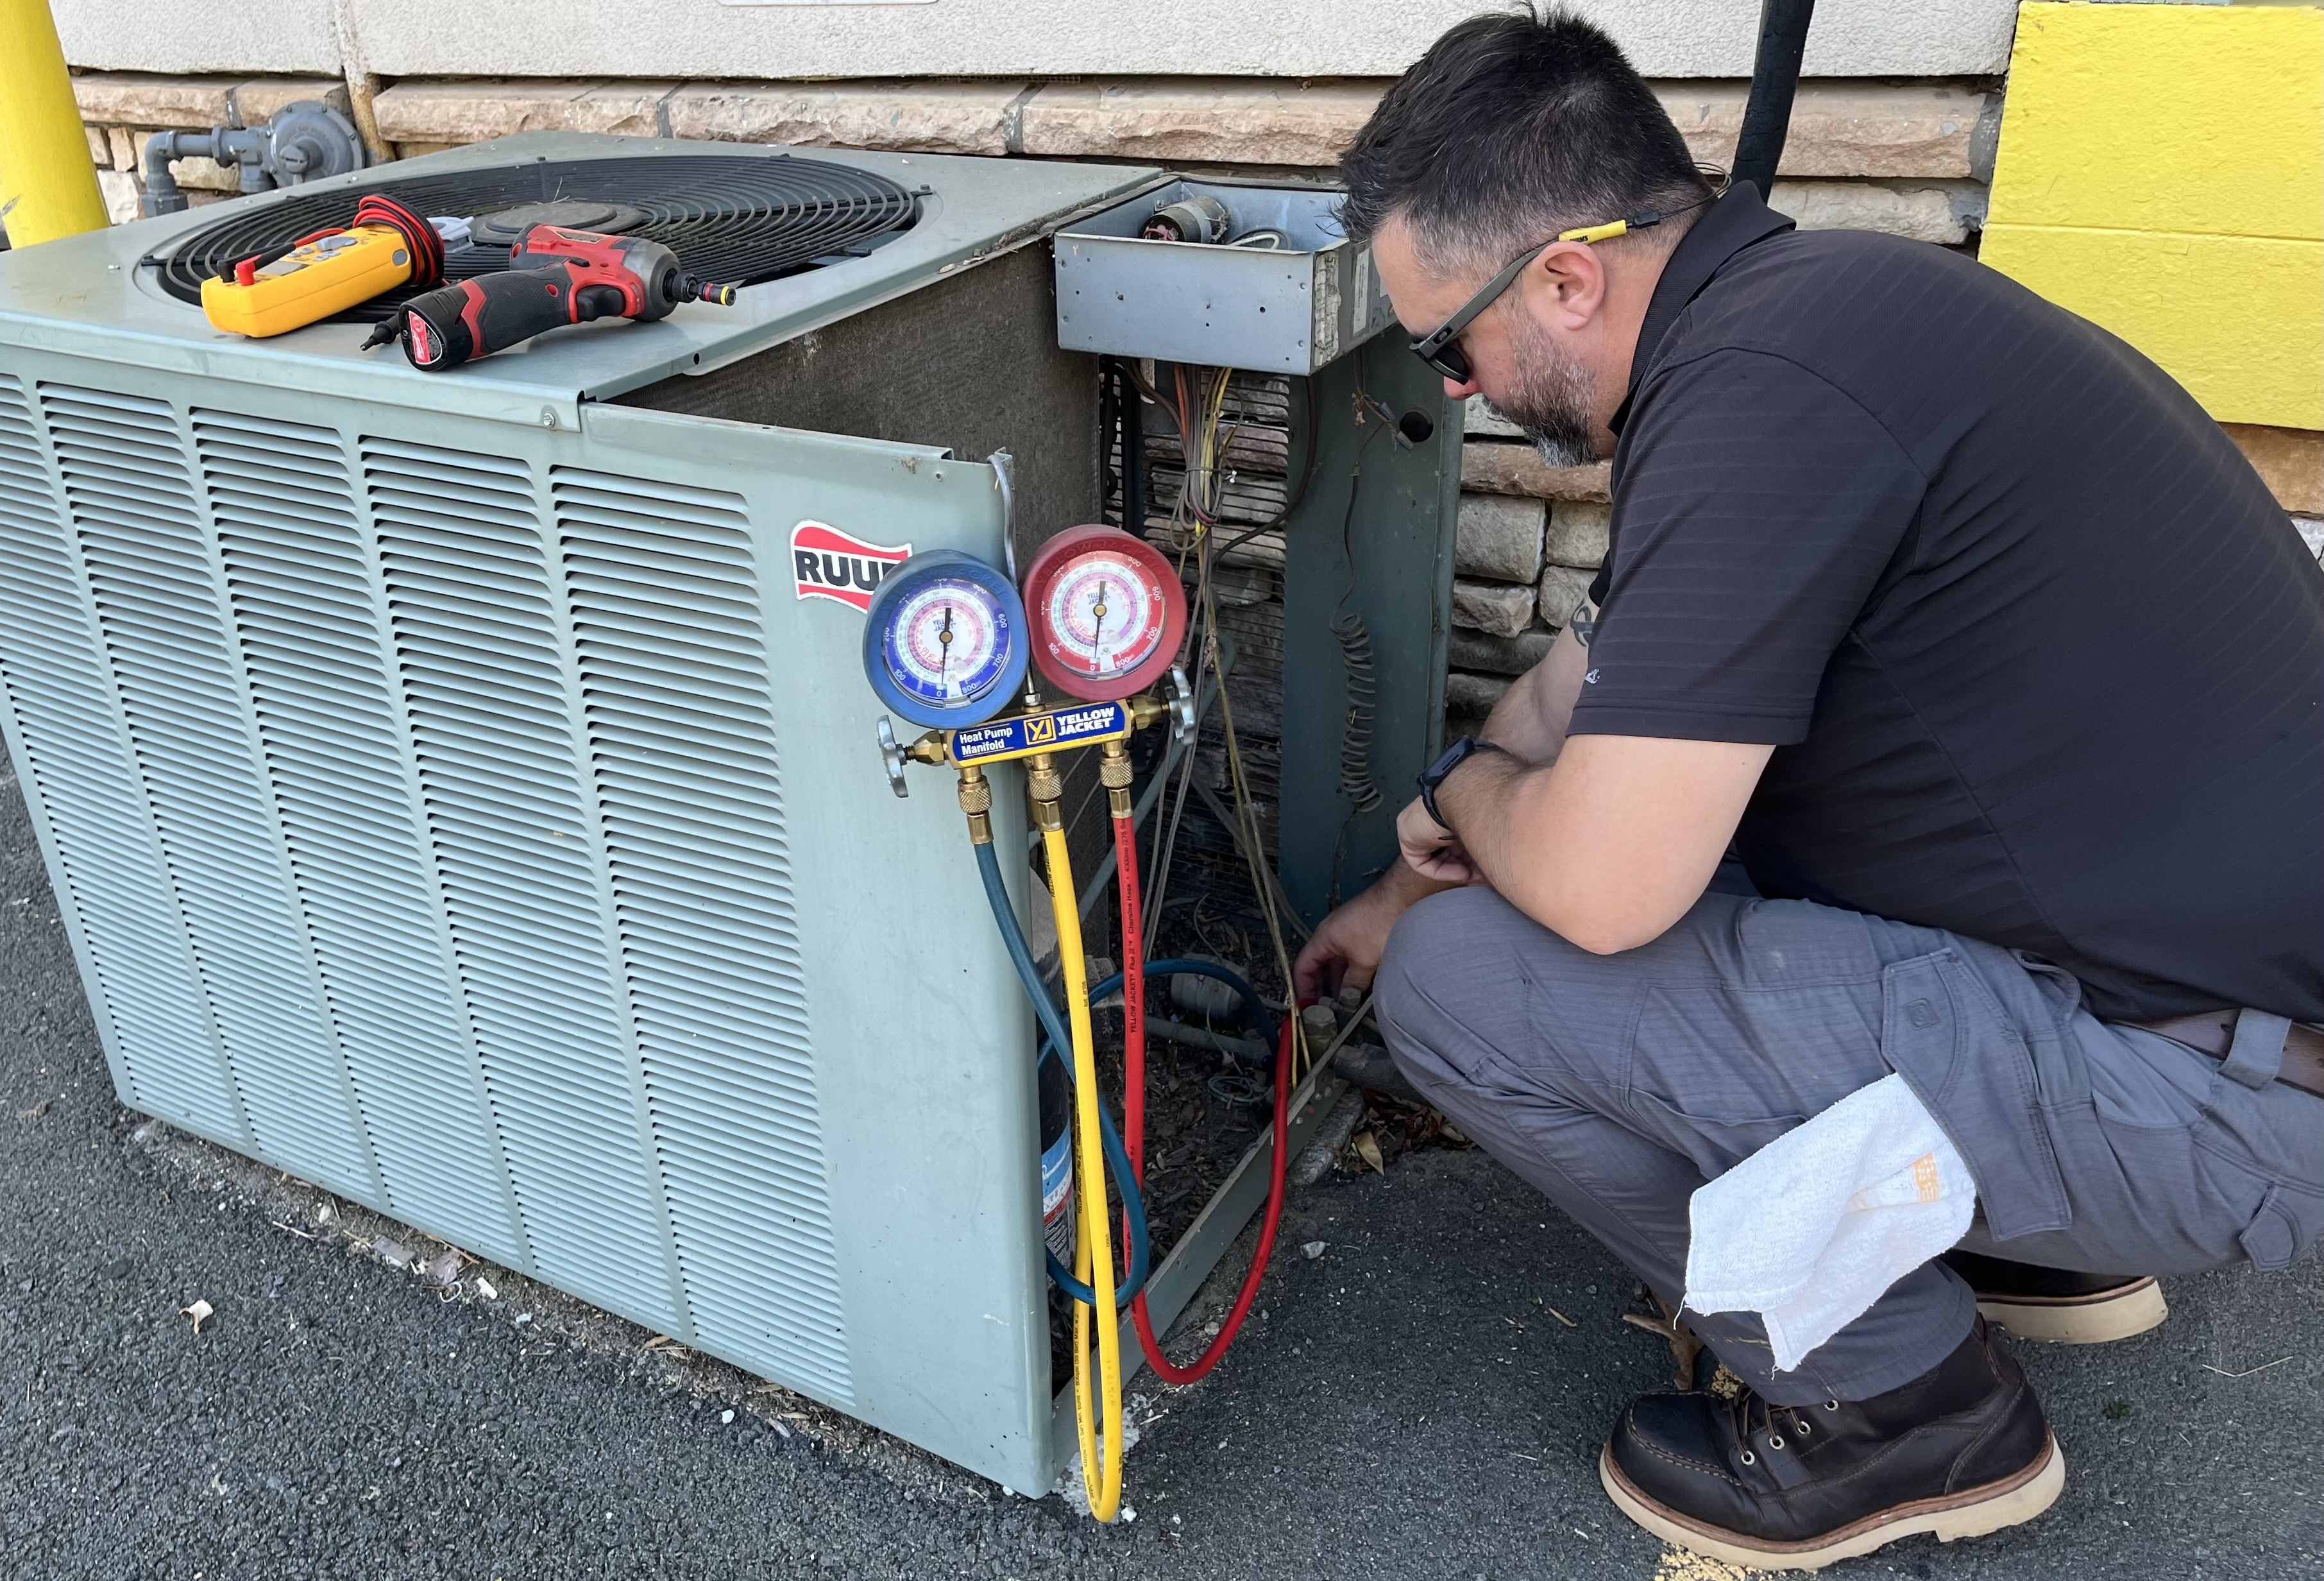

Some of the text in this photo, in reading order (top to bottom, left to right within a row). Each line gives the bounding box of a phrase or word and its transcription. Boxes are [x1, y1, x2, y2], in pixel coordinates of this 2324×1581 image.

[795, 550, 899, 591] RUU
[1152, 586, 1161, 601] 600
[998, 613, 1008, 628] 600
[1146, 626, 1157, 640] 700
[992, 654, 1003, 667] 700
[895, 669, 906, 680] 100
[1056, 706, 1114, 726] YELLOW
[1058, 718, 1112, 736] JACKET
[960, 727, 1013, 744] Heat Pump
[962, 739, 1005, 756] Manifold
